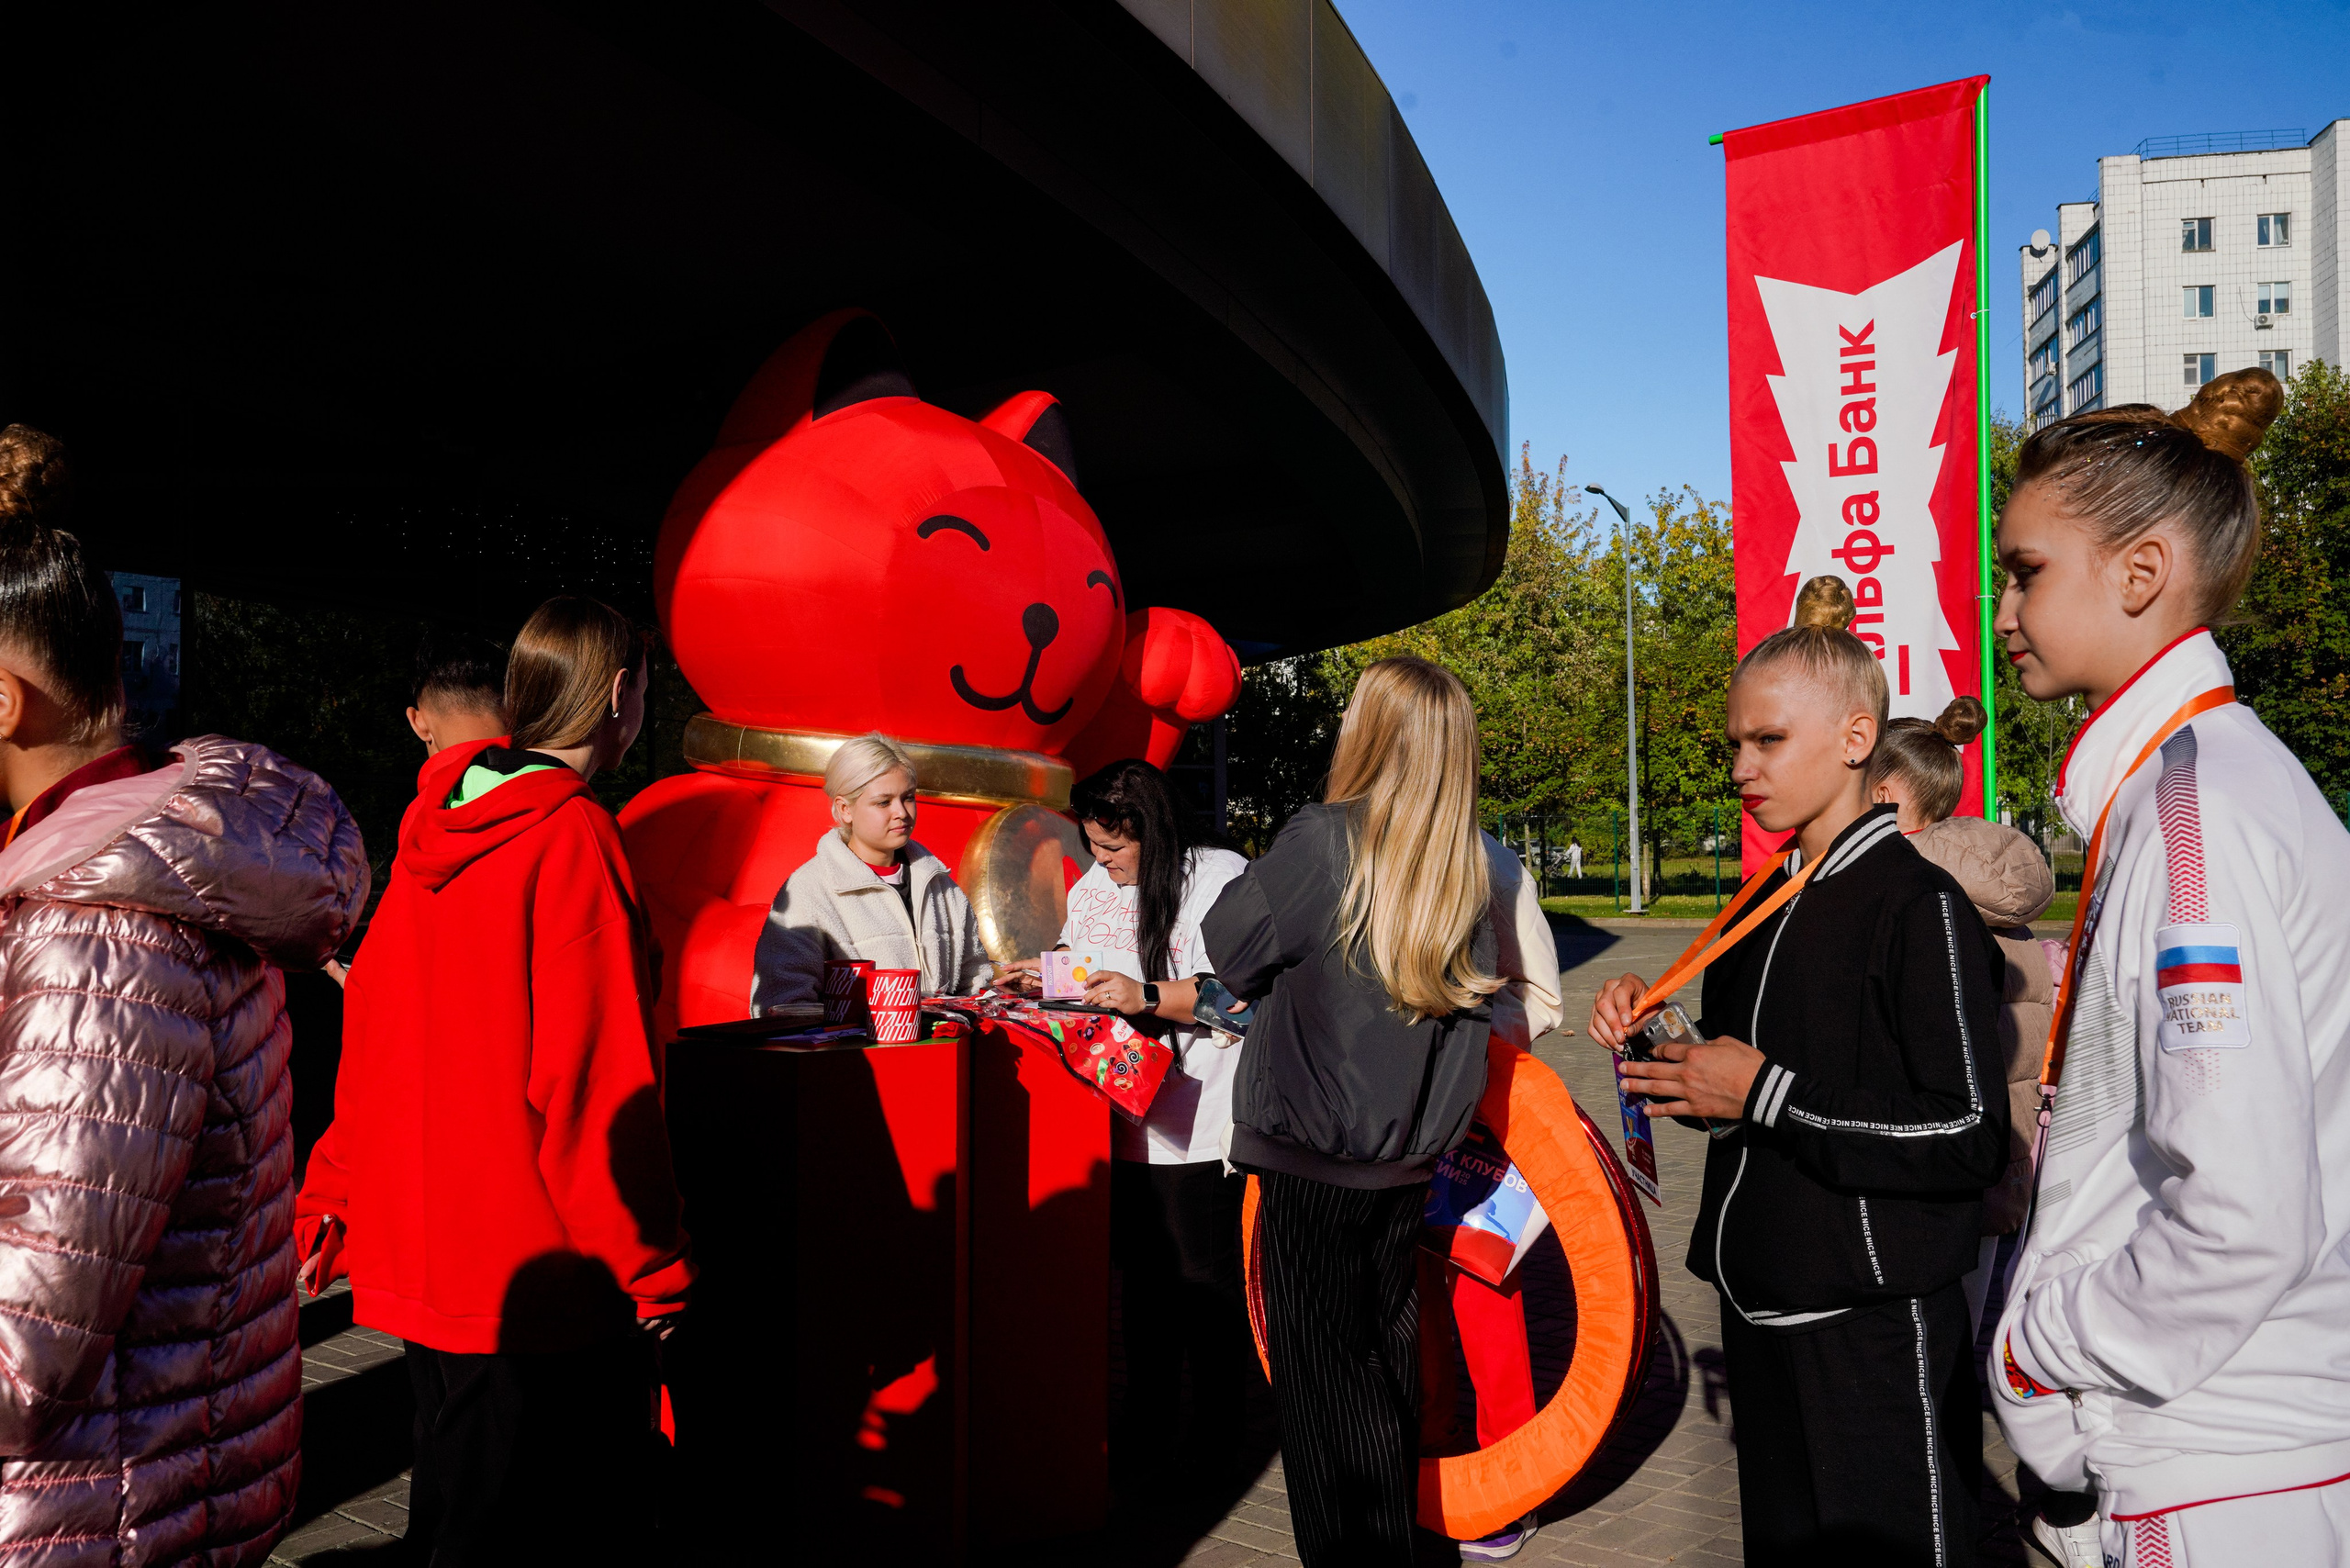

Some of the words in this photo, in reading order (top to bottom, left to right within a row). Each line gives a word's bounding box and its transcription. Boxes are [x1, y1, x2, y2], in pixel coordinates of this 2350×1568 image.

[1829, 318, 1878, 478] Банк
[1830, 490, 1895, 660] льфа
[1941, 900, 1949, 918] NICE
[1943, 918, 1953, 935] NICE
[1946, 935, 1955, 954] NICE
[1949, 955, 1957, 972] NICE
[1951, 973, 1959, 991] NICE
[2167, 992, 2232, 1009] RUSSIAN
[1955, 1010, 1964, 1027] NICE
[2177, 1020, 2224, 1034] TEAM
[1960, 1027, 1968, 1047] NICE
[1963, 1047, 1971, 1065] NICE
[1965, 1065, 1974, 1083] NICE
[1968, 1084, 1978, 1103] NICE
[1830, 1118, 1851, 1127] NICE
[1851, 1120, 1869, 1128] NICE
[1869, 1122, 1889, 1131] NICE
[1458, 1176, 1469, 1186] 25
[1460, 1153, 1528, 1193] КЛУБОВ
[1460, 1170, 1471, 1180] 20
[1859, 1200, 1868, 1217] NICE
[1862, 1217, 1872, 1237] NICE
[1865, 1237, 1876, 1257] NICE
[1870, 1256, 1882, 1276] NICE
[1911, 1305, 1920, 1322] NICE
[1915, 1323, 1923, 1341] NICE
[1916, 1341, 1924, 1359] NICE
[1921, 1397, 1931, 1417] NICE
[1925, 1417, 1933, 1436] NICE
[1927, 1455, 1937, 1474] NICE
[1930, 1475, 1938, 1495] NICE
[1930, 1495, 1939, 1514] NICE
[1933, 1534, 1942, 1553] NICE
